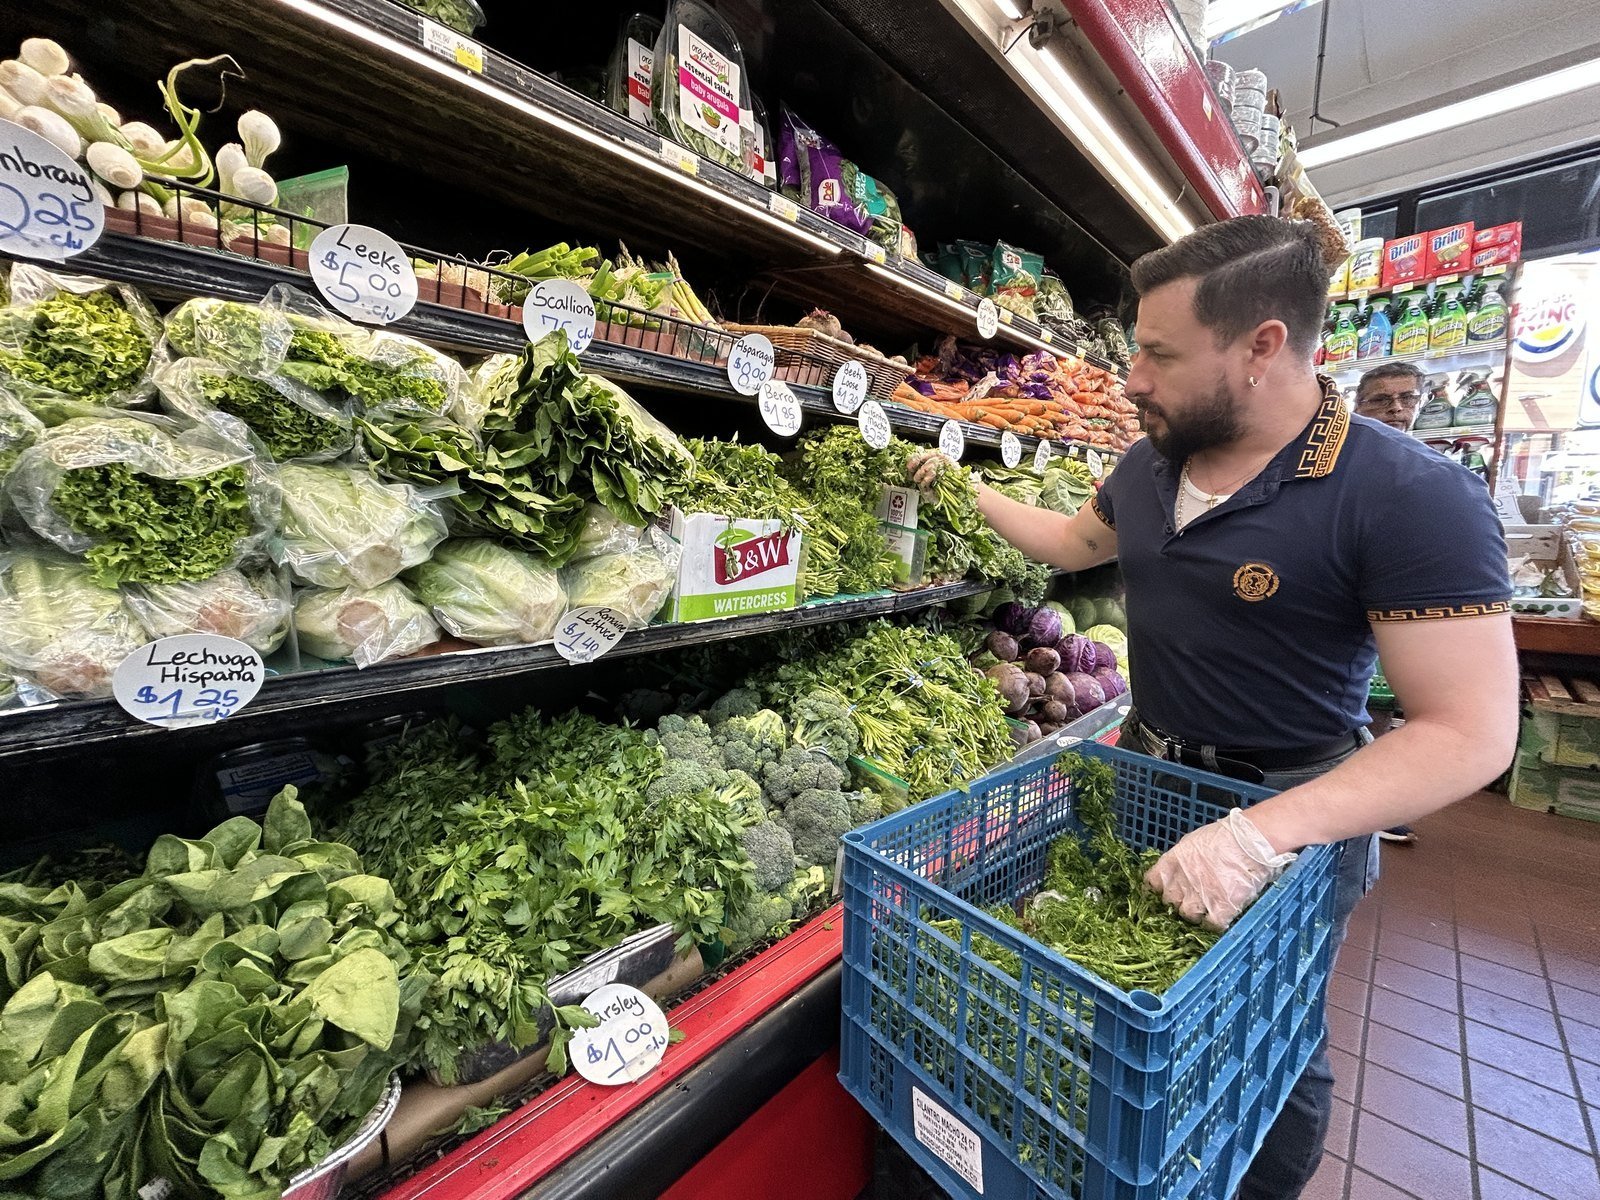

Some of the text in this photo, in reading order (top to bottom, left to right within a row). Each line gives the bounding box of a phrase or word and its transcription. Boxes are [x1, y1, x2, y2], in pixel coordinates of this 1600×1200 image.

[684, 60, 734, 101] essential salads
[690, 80, 730, 113] baby arugula
[823, 182, 833, 202] Dole
[336, 226, 401, 275] Leeks
[1391, 239, 1420, 261] Brillo
[1433, 228, 1465, 251] Brillo
[1475, 249, 1497, 265] Brillo
[533, 286, 595, 317] Scallions
[735, 340, 774, 367] Asparagus
[841, 375, 859, 390] Loose
[844, 362, 862, 380] Beets
[764, 383, 794, 404] Berro
[714, 591, 787, 614] WATERCRESS
[576, 611, 616, 641] Lettuce
[146, 643, 258, 673] Lechuga
[583, 995, 645, 1024] arsley
[916, 1098, 940, 1123] CILANTRO
[941, 1116, 960, 1139] MACHO
[955, 1159, 978, 1182] MEXICO
